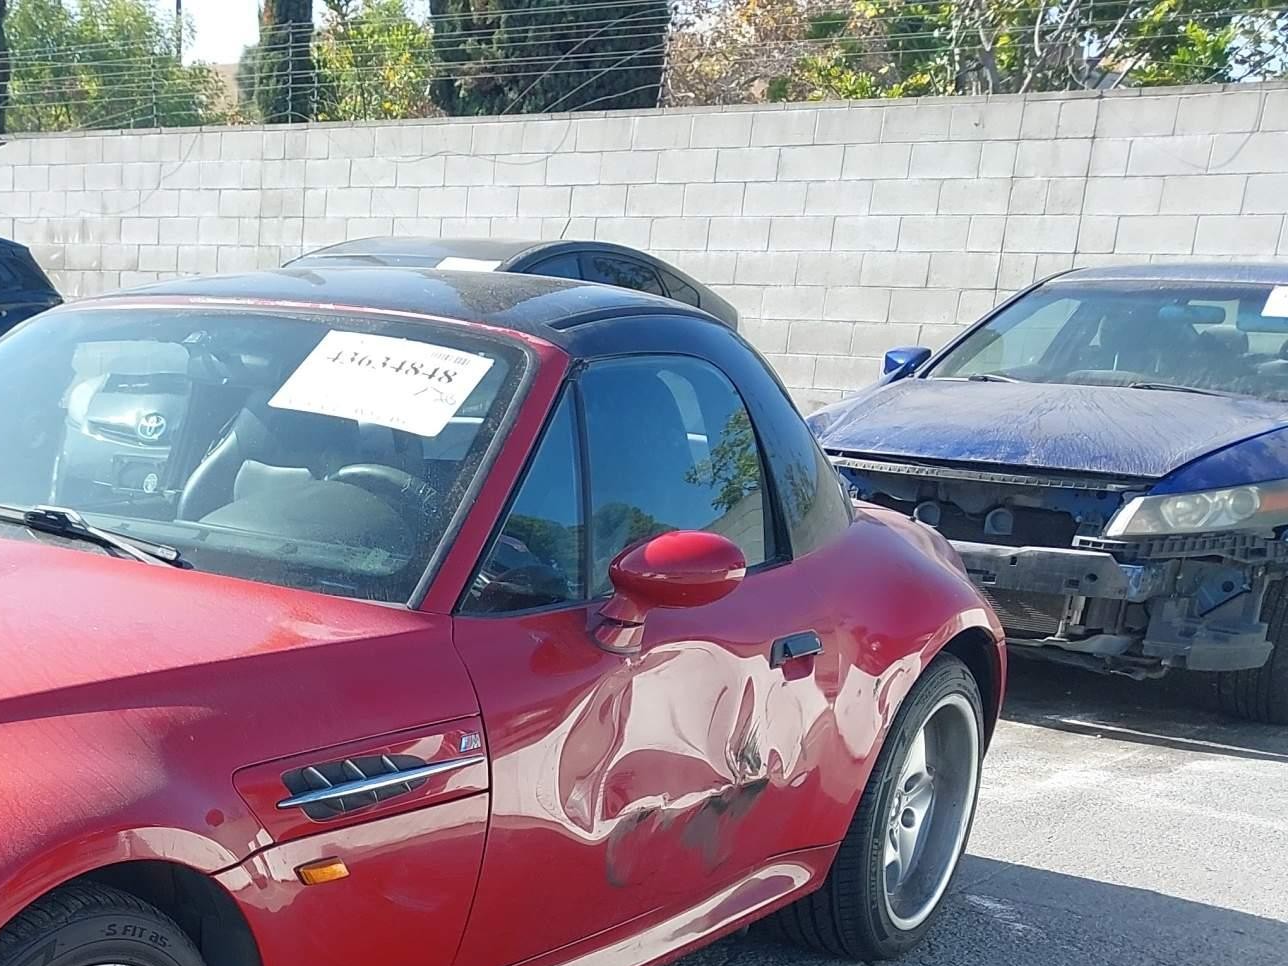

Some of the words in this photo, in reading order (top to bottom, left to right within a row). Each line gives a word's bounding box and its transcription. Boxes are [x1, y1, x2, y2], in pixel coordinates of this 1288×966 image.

[327, 351, 458, 384] 43634848
[105, 923, 117, 937] S
[122, 924, 147, 938] FIT
